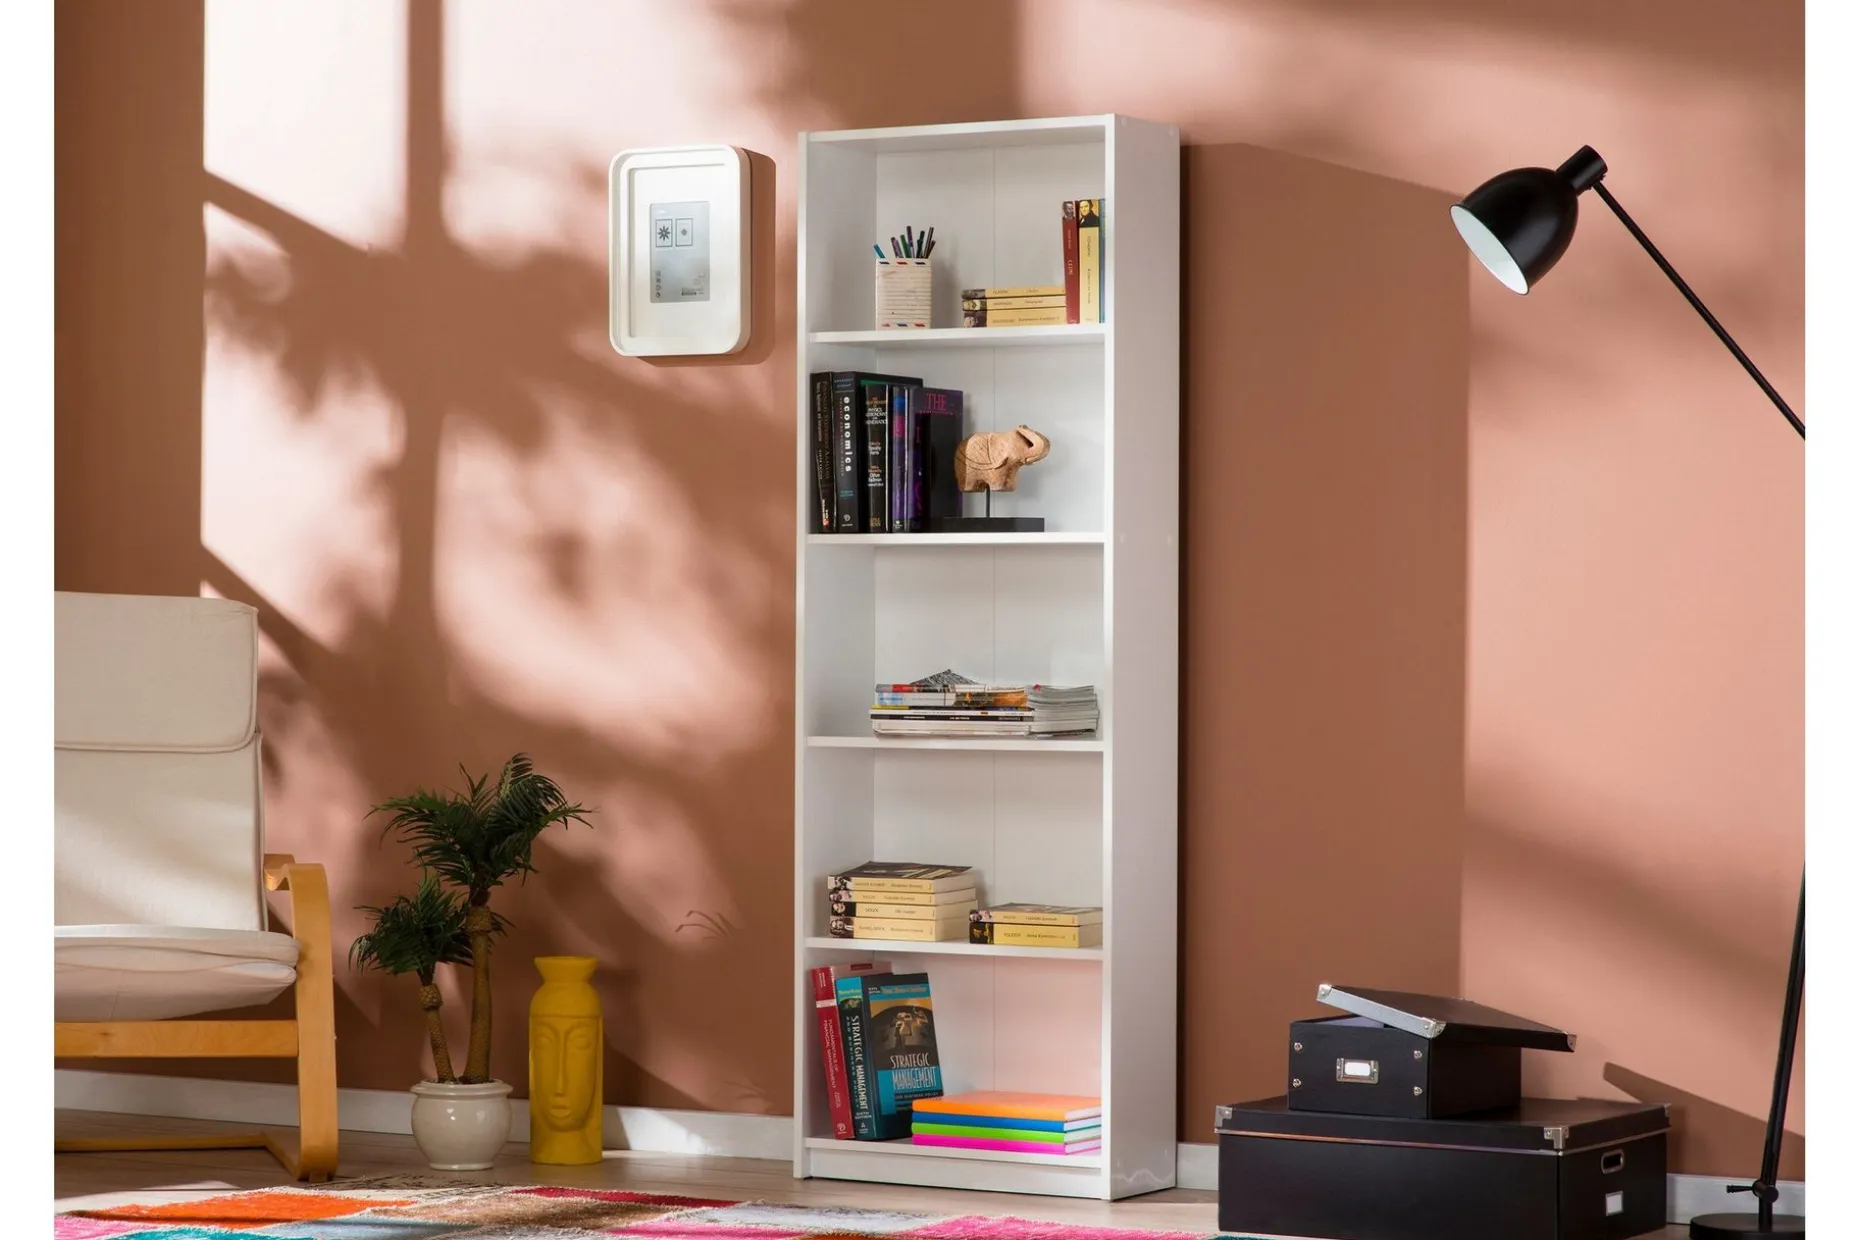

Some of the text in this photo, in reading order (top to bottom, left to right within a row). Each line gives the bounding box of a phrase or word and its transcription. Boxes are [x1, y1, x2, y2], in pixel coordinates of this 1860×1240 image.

[926, 392, 948, 411] THE
[843, 396, 853, 472] economics
[850, 1015, 869, 1110] STRATEGIC MANAGEMENT
[889, 1052, 931, 1069] STRATEGIC
[891, 1066, 937, 1090] MANAGEMENT
